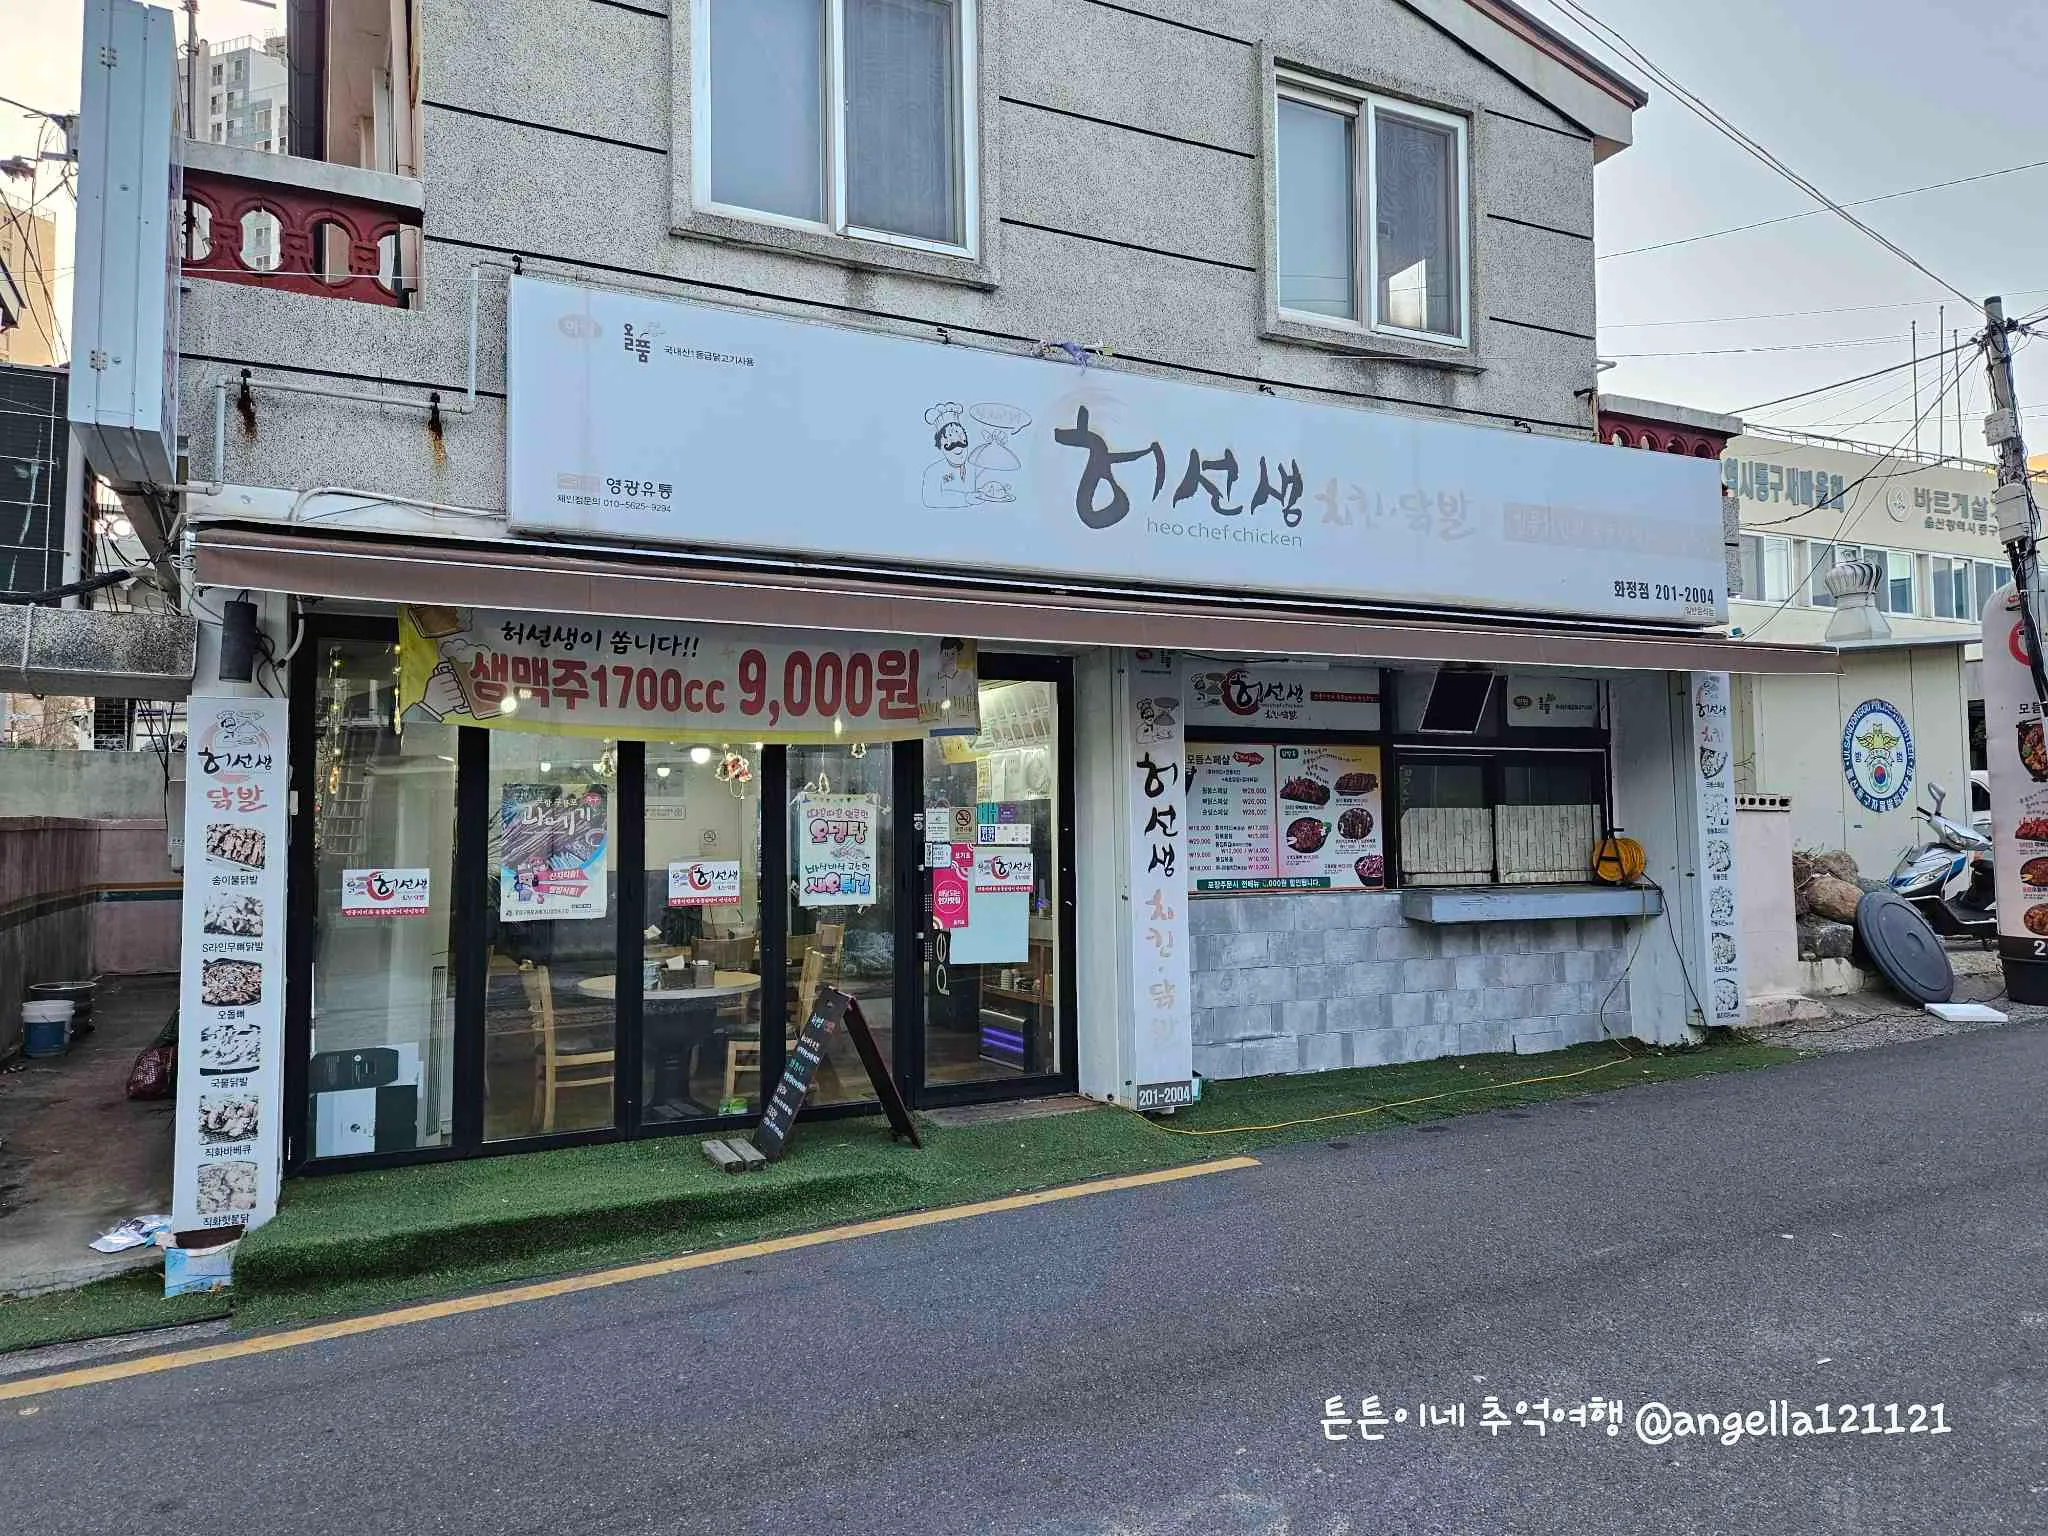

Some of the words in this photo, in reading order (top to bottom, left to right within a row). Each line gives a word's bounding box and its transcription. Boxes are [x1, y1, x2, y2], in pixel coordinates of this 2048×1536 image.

[1054, 405, 1303, 529] 허선생
[606, 478, 672, 499] 영광유통
[1914, 487, 1998, 521] 바르게살
[1147, 516, 1184, 535] heo
[1188, 522, 1229, 541] chef
[1232, 527, 1303, 549] chicken
[1614, 580, 1649, 600] 화정점
[1655, 584, 1715, 604] 201-2004
[501, 621, 602, 652] 허선생이
[738, 648, 920, 727] 9,000원
[197, 747, 273, 775] 허선생
[207, 783, 269, 813] 닭발
[1139, 1085, 1191, 1106] 201-2004
[204, 1144, 252, 1158] 직화바베큐
